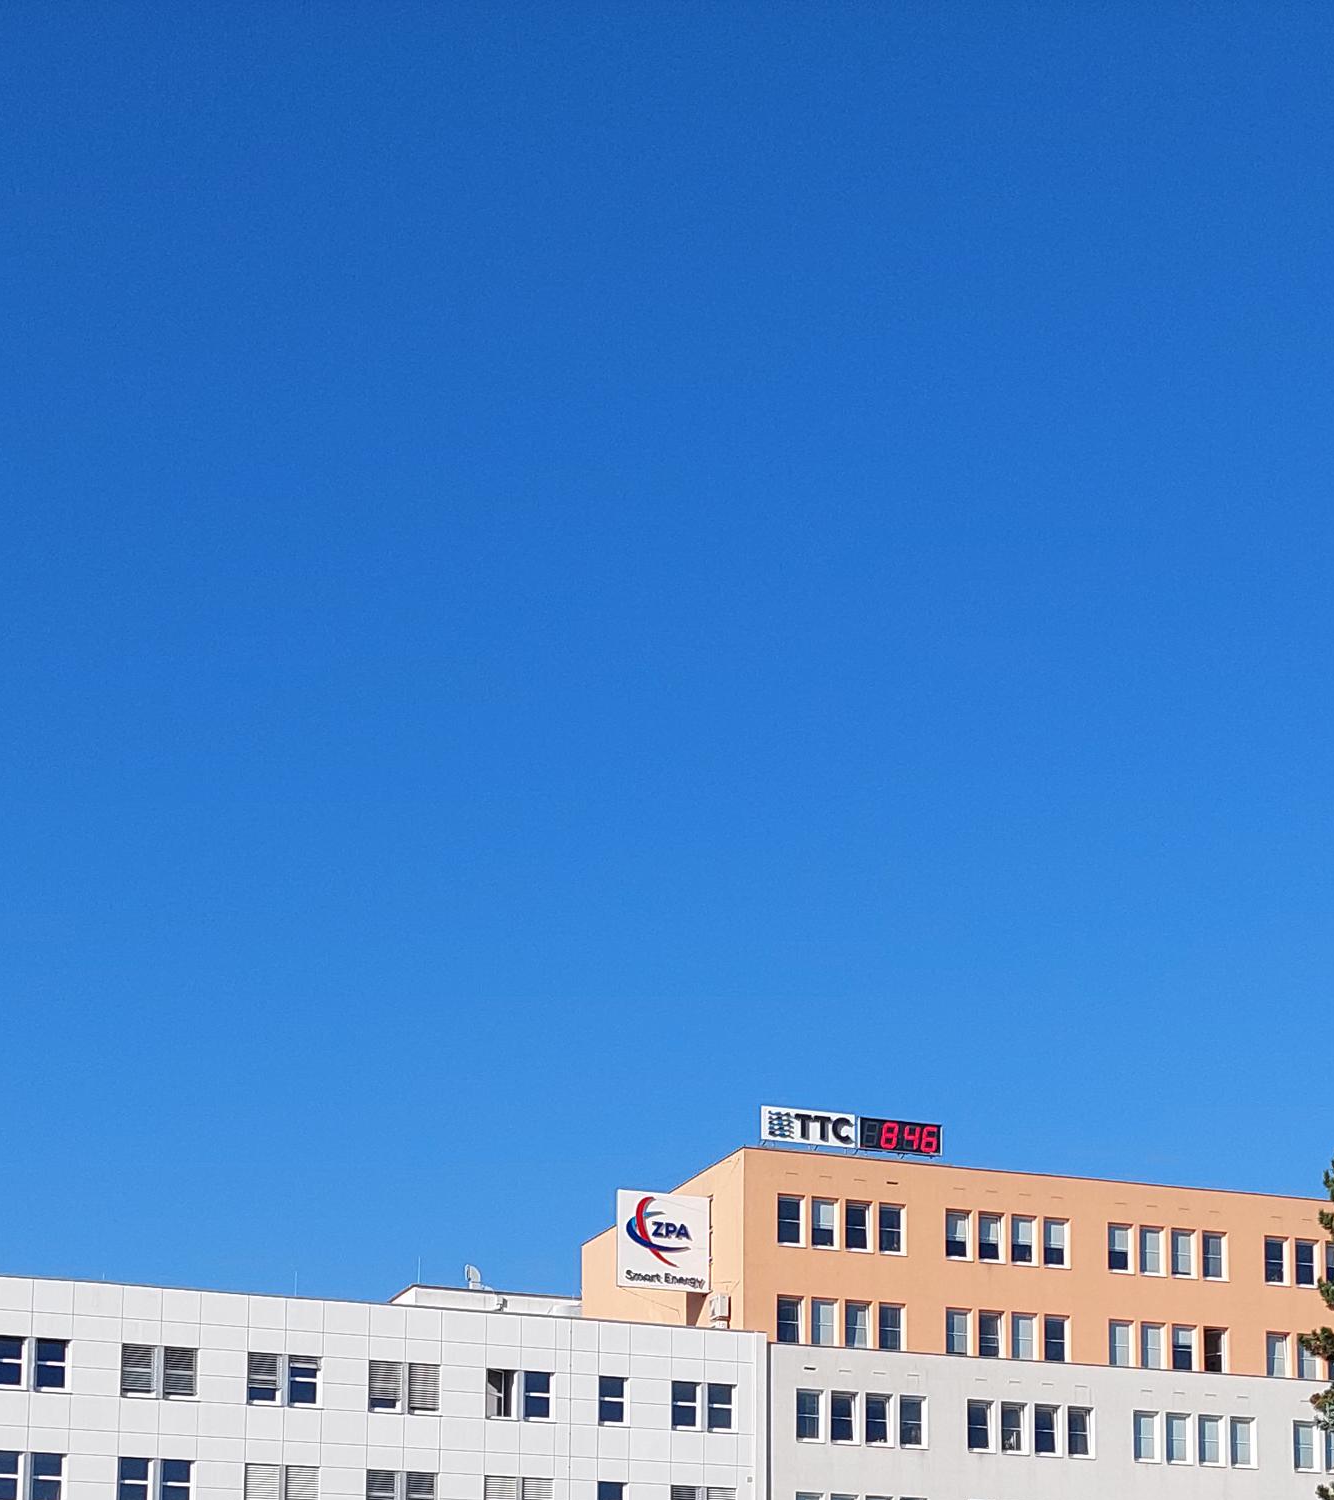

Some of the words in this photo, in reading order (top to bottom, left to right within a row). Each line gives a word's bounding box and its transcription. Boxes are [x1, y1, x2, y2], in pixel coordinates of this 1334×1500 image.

[794, 1113, 855, 1145] TTC
[651, 1221, 693, 1241] ZPA
[625, 1269, 662, 1284] Smart
[664, 1272, 705, 1289] Energy
